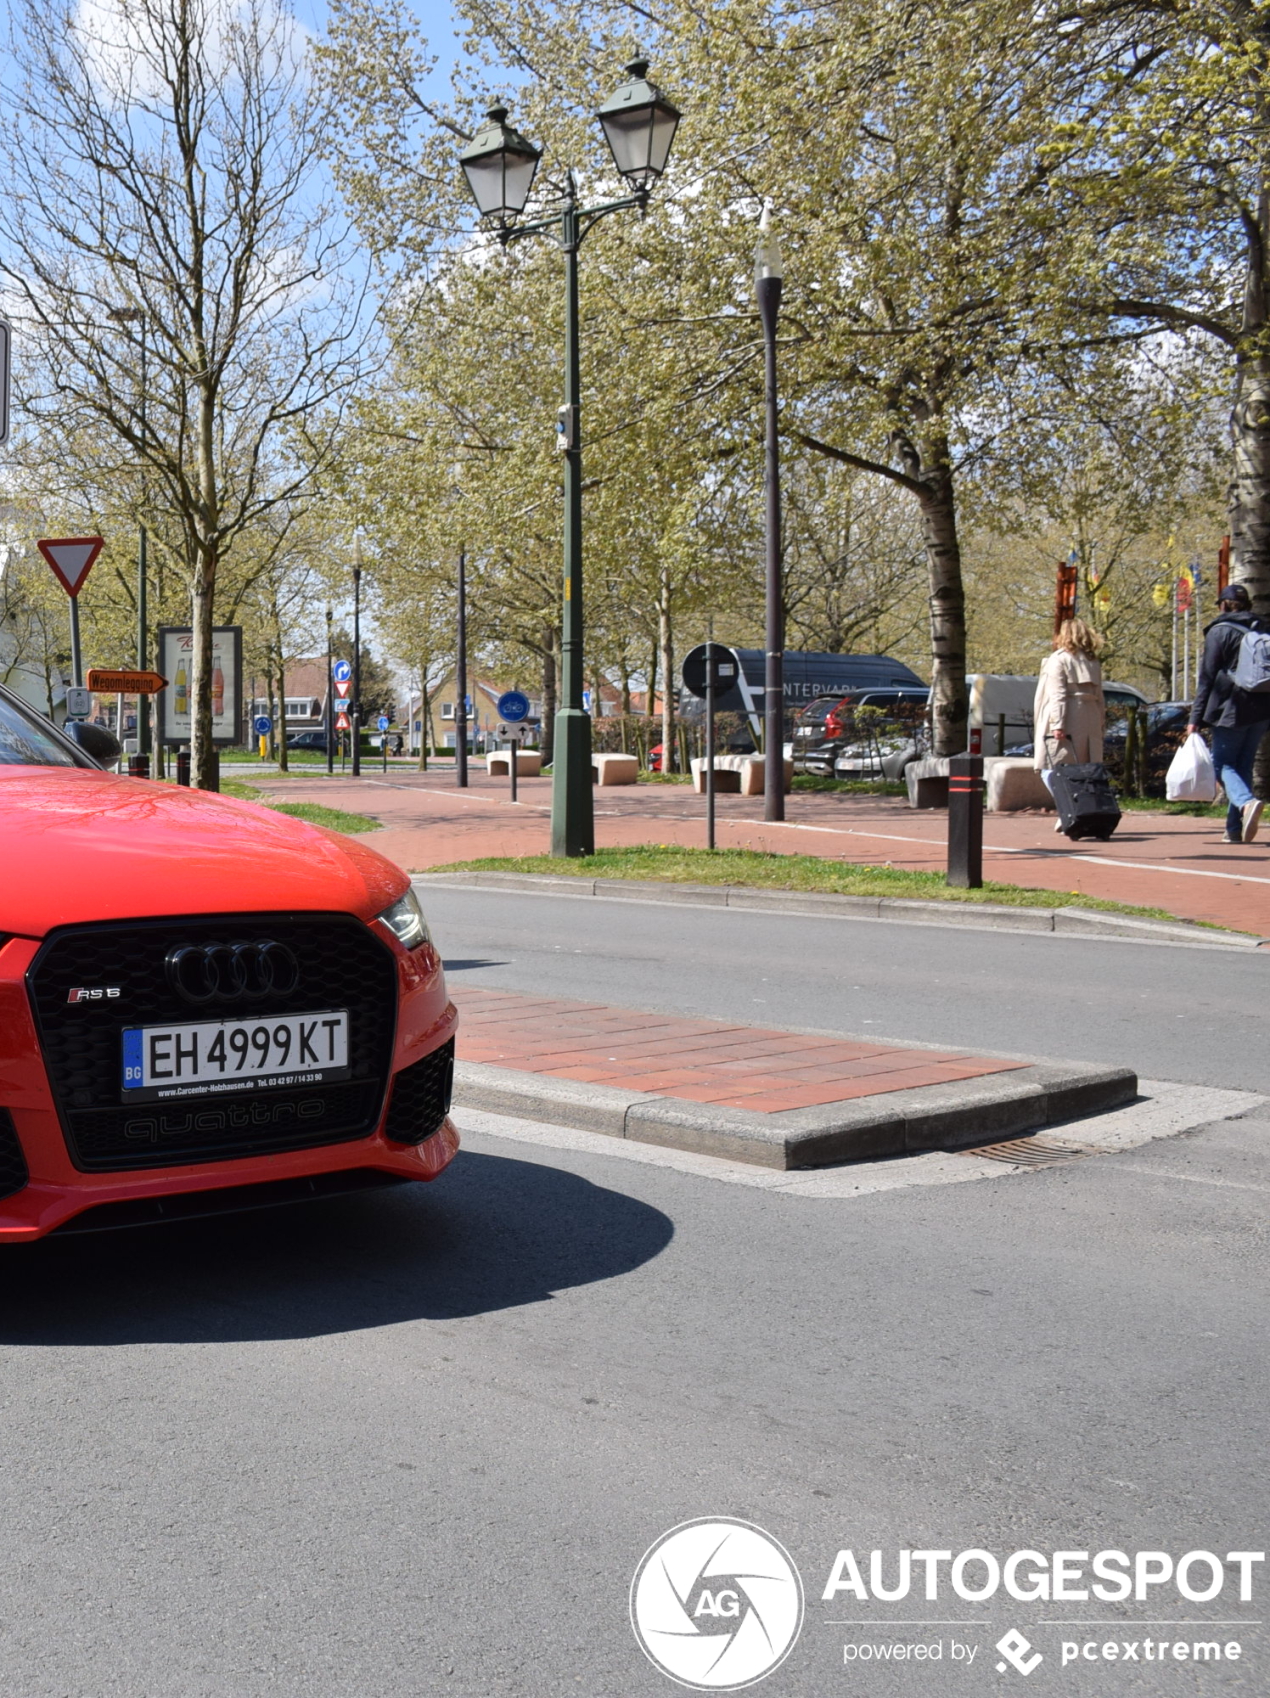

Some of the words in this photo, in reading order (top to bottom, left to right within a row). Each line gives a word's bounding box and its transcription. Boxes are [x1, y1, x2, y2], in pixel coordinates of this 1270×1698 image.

[91, 674, 154, 692] Wegomlegging
[125, 1066, 142, 1081] BG
[158, 1081, 255, 1097] www.Carcenter-Holzhausen.de
[257, 1078, 268, 1088] Tel.
[269, 1077, 277, 1087] 03
[278, 1076, 286, 1086] 42
[314, 1072, 323, 1082] 90
[124, 1099, 326, 1143] quattro
